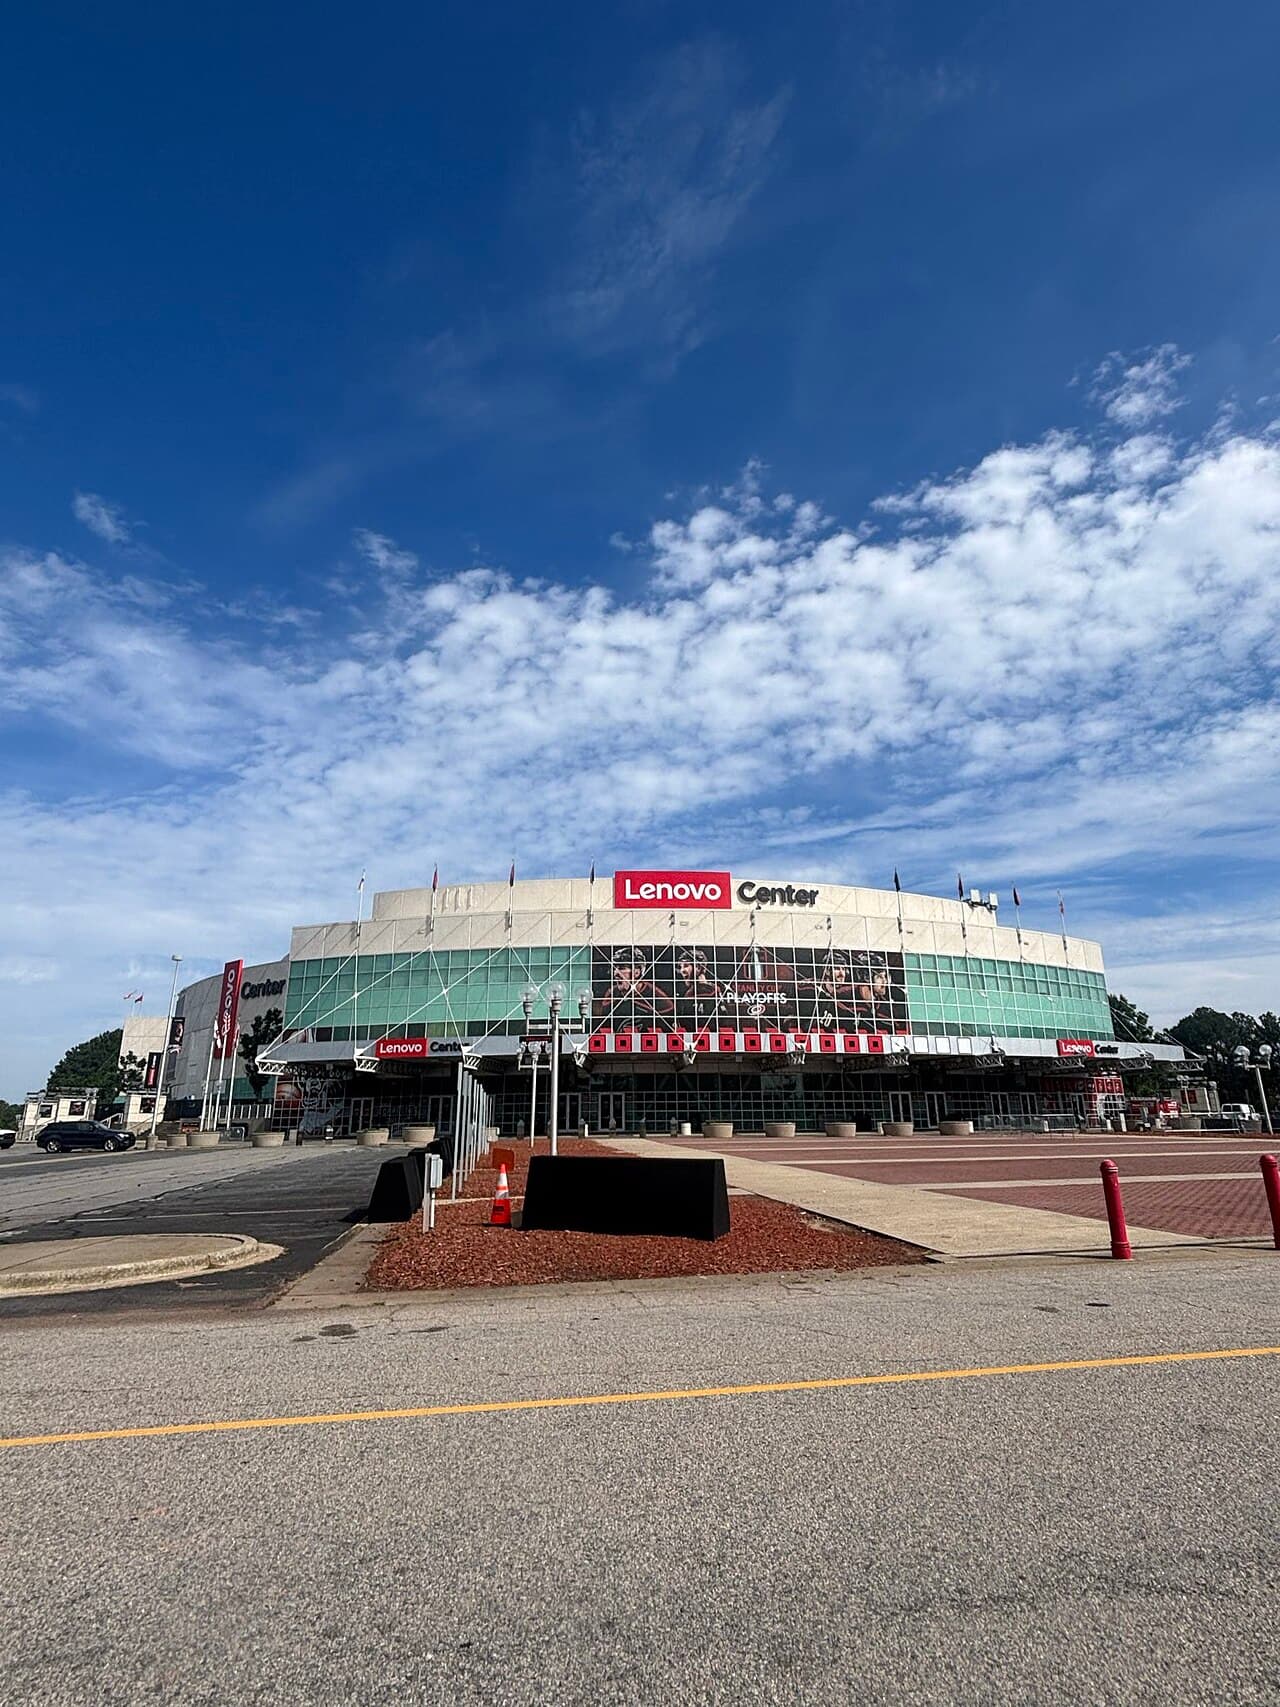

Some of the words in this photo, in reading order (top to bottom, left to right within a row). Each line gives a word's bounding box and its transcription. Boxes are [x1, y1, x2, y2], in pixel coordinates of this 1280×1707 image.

[625, 879, 721, 901] Lenovo
[738, 881, 819, 906] Center
[241, 979, 286, 1000] Center
[727, 992, 788, 1004] PLAYOFFS
[380, 1043, 422, 1054] Lenovo
[1062, 1042, 1092, 1054] Lenovo
